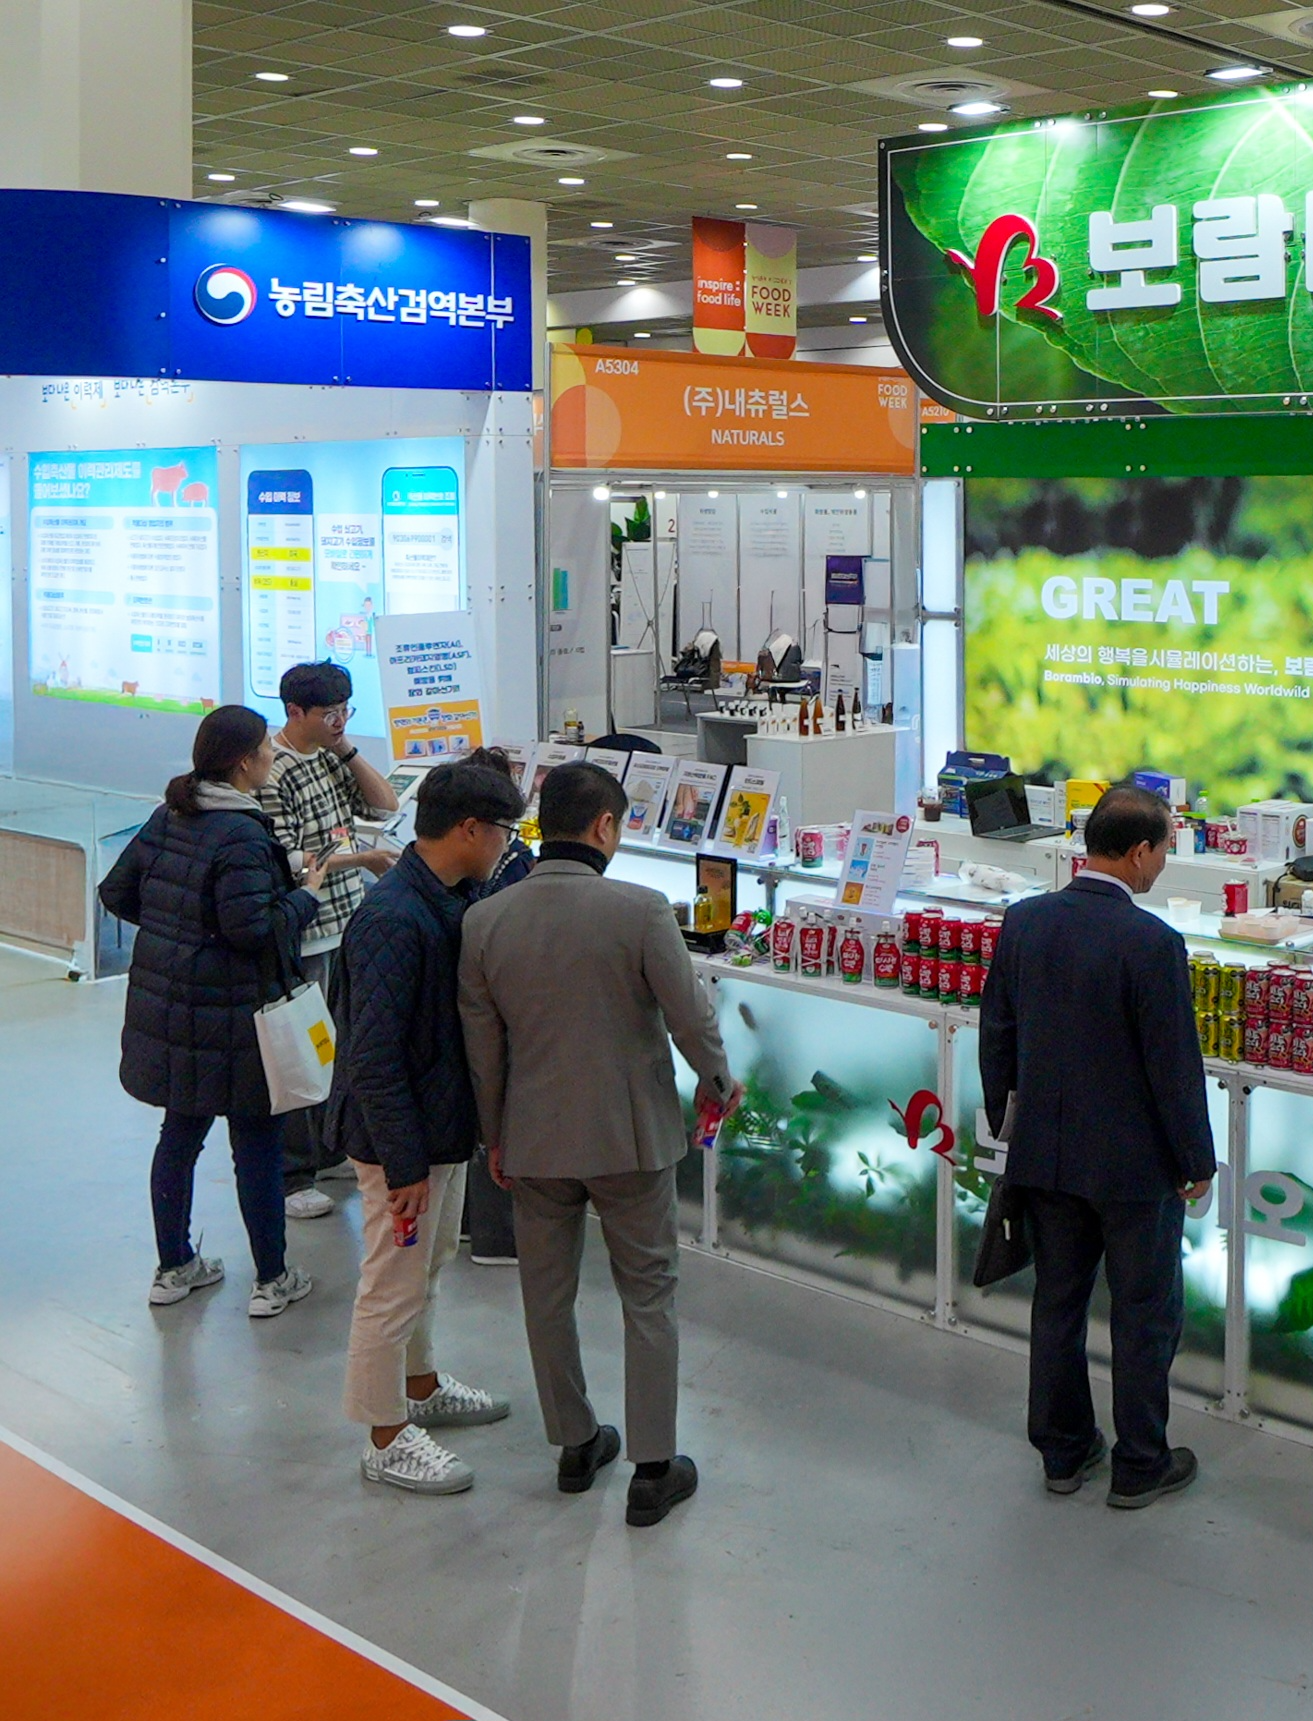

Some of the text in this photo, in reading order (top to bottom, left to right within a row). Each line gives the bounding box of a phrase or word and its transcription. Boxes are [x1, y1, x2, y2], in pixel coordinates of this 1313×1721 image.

[697, 276, 734, 292] inspire
[697, 291, 741, 307] food life
[751, 285, 791, 302] FOOD
[268, 277, 515, 329] 농림축산검역본부
[752, 301, 791, 318] WEEK
[595, 359, 639, 376] A5304
[878, 384, 908, 396] FOOD
[683, 385, 810, 421] (주)내츄럴스
[879, 397, 908, 409] WEEK
[711, 428, 785, 447] NATURALS
[668, 518, 676, 533] 2
[1041, 575, 1230, 625] GREAT
[1044, 643, 1093, 663] 세상의
[1044, 670, 1106, 686] Borambio,
[1107, 673, 1171, 692] Simulating
[1173, 678, 1241, 695] Happiness
